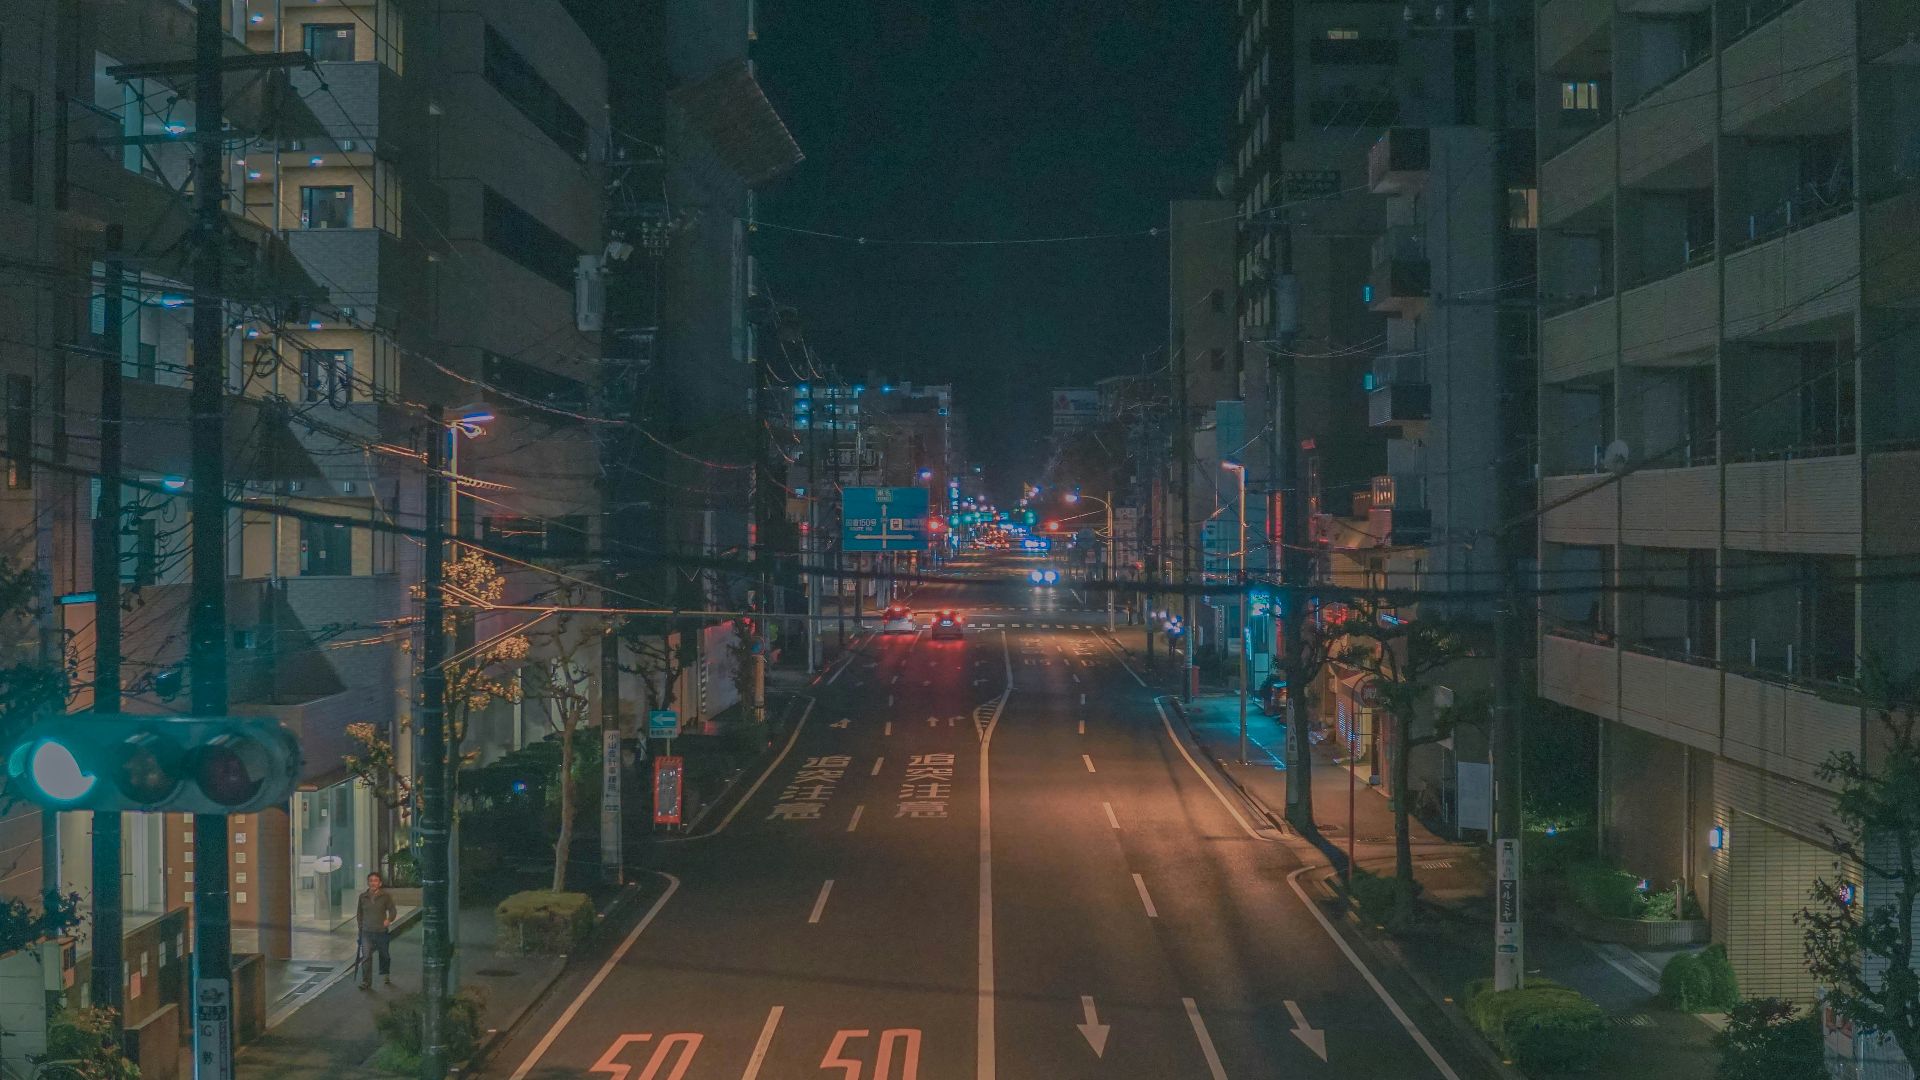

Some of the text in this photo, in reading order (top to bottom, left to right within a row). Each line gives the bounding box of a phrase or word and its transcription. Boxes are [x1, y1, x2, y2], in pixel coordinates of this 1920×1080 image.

[765, 753, 853, 819] 追突注意
[894, 752, 956, 818] 追突注意
